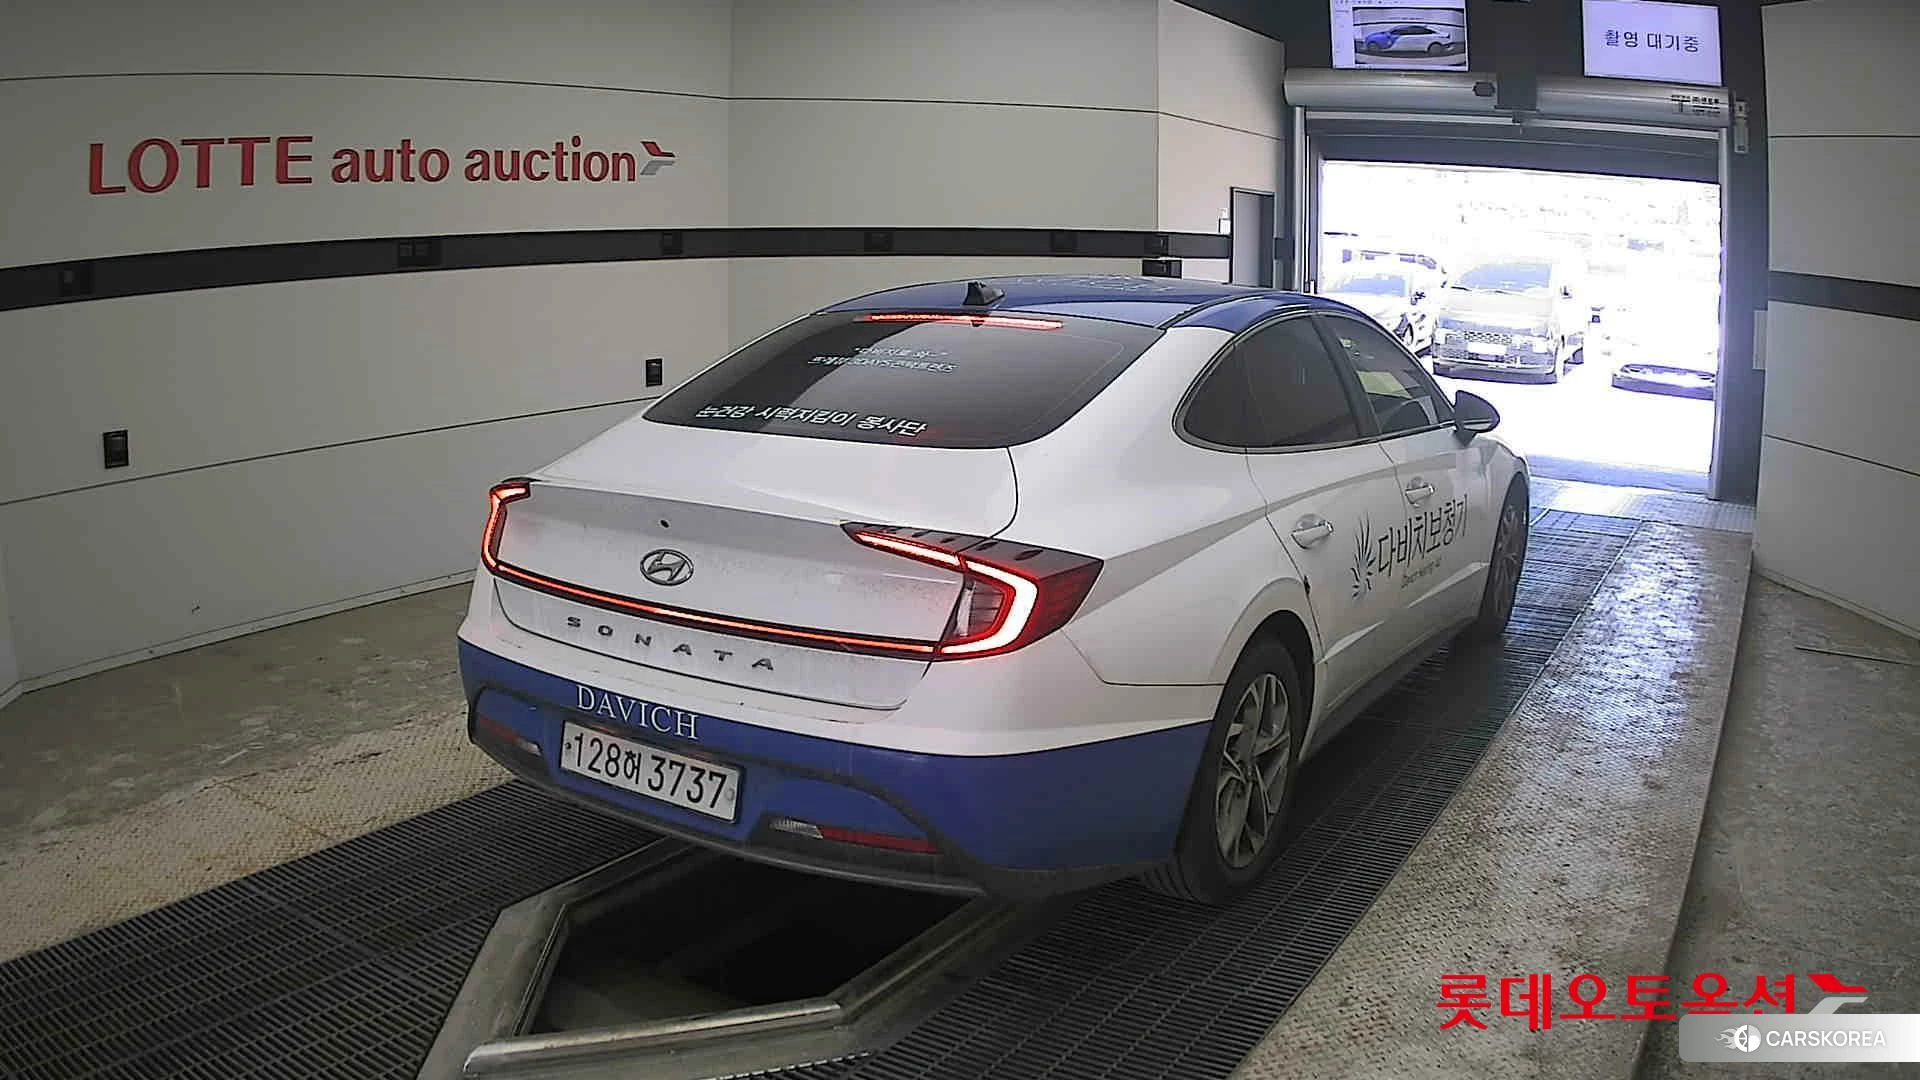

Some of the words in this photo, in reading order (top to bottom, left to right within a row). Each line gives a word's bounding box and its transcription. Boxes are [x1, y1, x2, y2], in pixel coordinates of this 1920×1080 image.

[1604, 29, 1638, 48] 촬영
[1647, 32, 1699, 53] 대기중
[88, 135, 313, 195] LOTTE
[331, 138, 450, 183] auto
[463, 135, 637, 183] auction
[695, 405, 754, 418] 눈건강
[755, 407, 857, 427] 시력지킴이
[857, 415, 928, 437] 봉사단
[1378, 493, 1467, 577] 다비치보청기
[567, 615, 774, 671] SONATA
[576, 685, 699, 740] DAVICH
